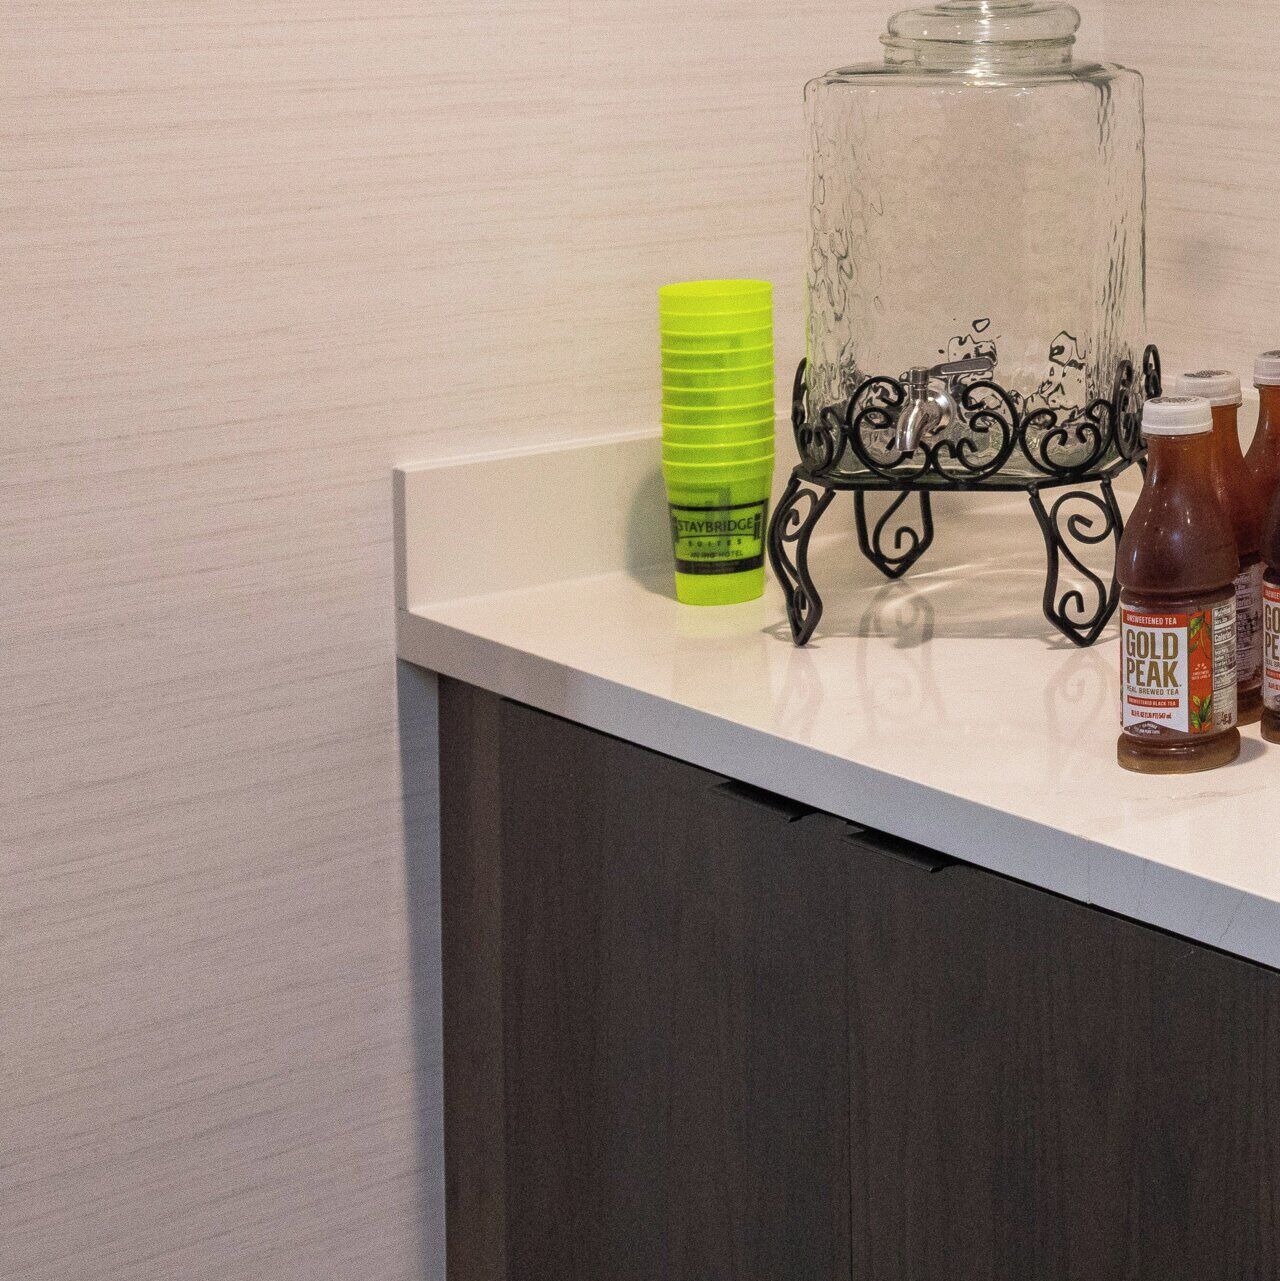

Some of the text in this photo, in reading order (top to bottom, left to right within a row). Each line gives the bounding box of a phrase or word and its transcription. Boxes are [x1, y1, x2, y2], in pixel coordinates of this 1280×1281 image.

[677, 517, 753, 533] STAYBRIDGE
[1165, 617, 1177, 625] TEA
[1126, 629, 1179, 659] GOLD
[1126, 657, 1179, 688] PEAK
[1139, 687, 1164, 695] BREWED
